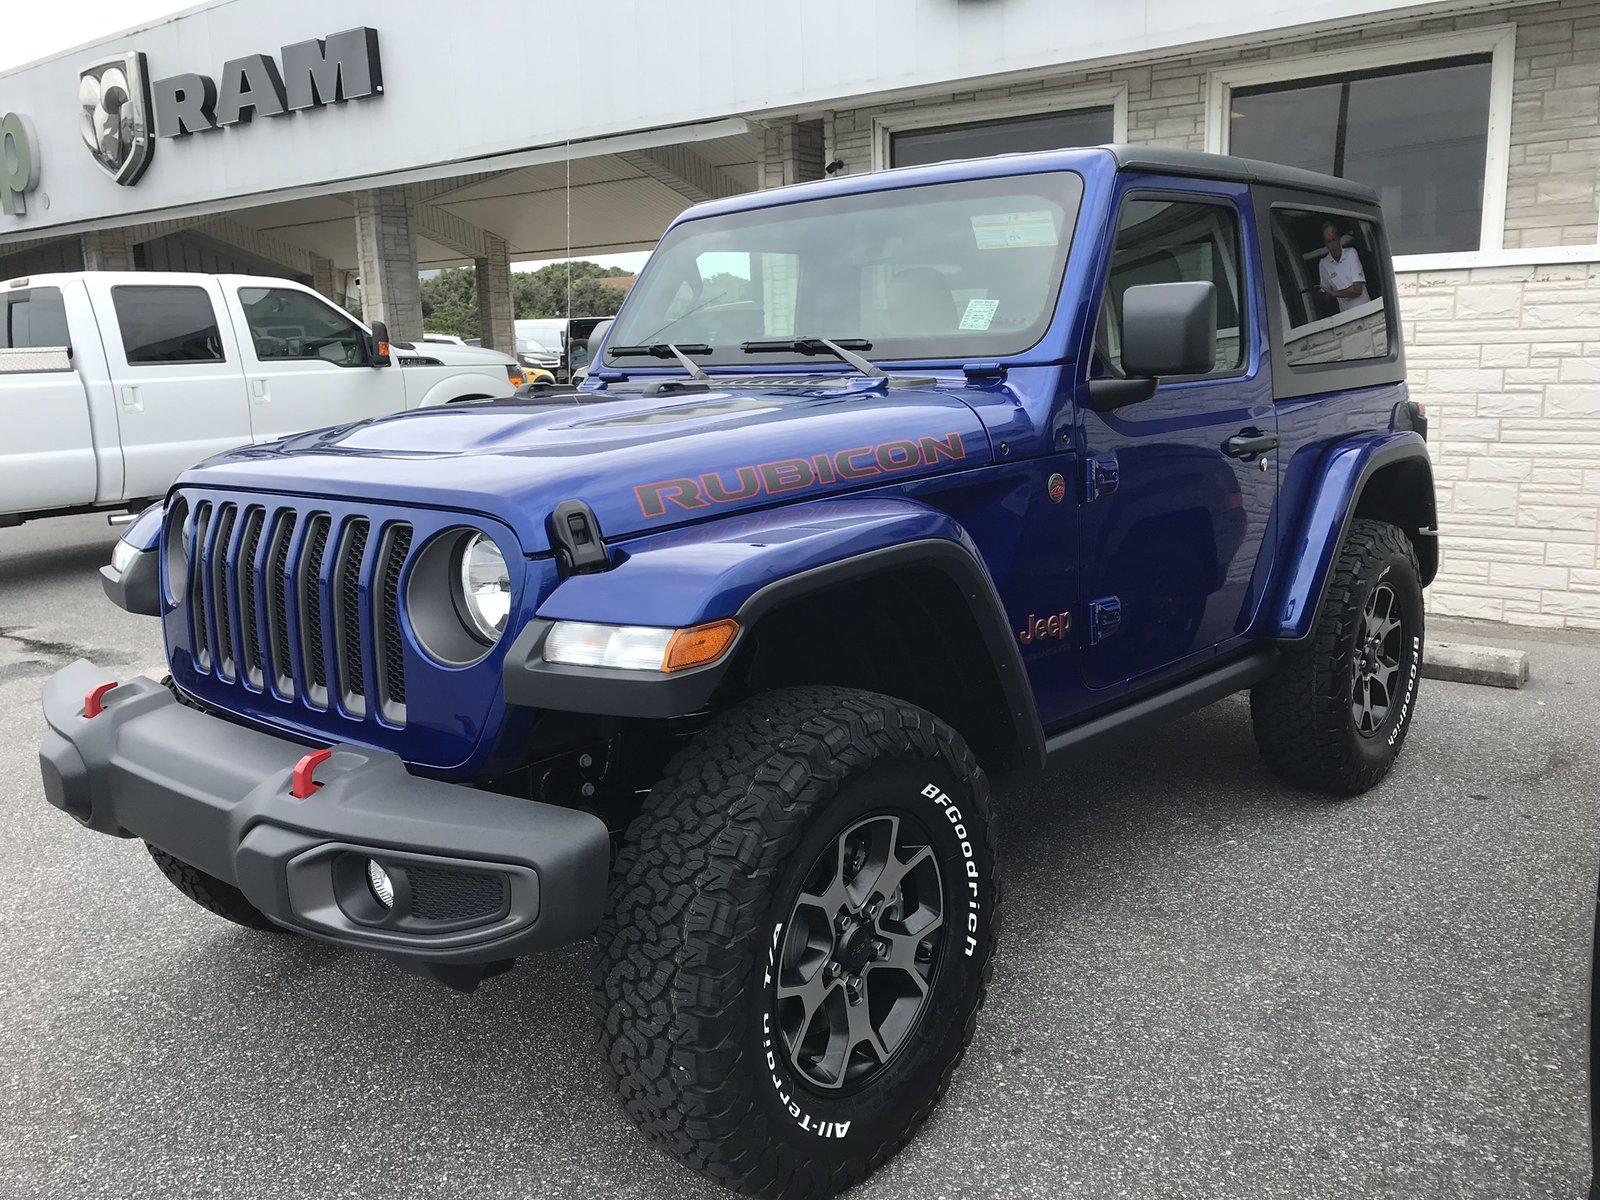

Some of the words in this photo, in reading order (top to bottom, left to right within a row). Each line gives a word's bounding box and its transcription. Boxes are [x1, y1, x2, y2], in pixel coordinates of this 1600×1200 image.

[153, 26, 384, 139] RAM
[633, 431, 967, 519] RUBICON
[1019, 611, 1073, 645] Jeep
[1387, 636, 1420, 747] BFGoodrich
[920, 783, 979, 958] BFGoodrich
[762, 1012, 851, 1140] All-Terrain
